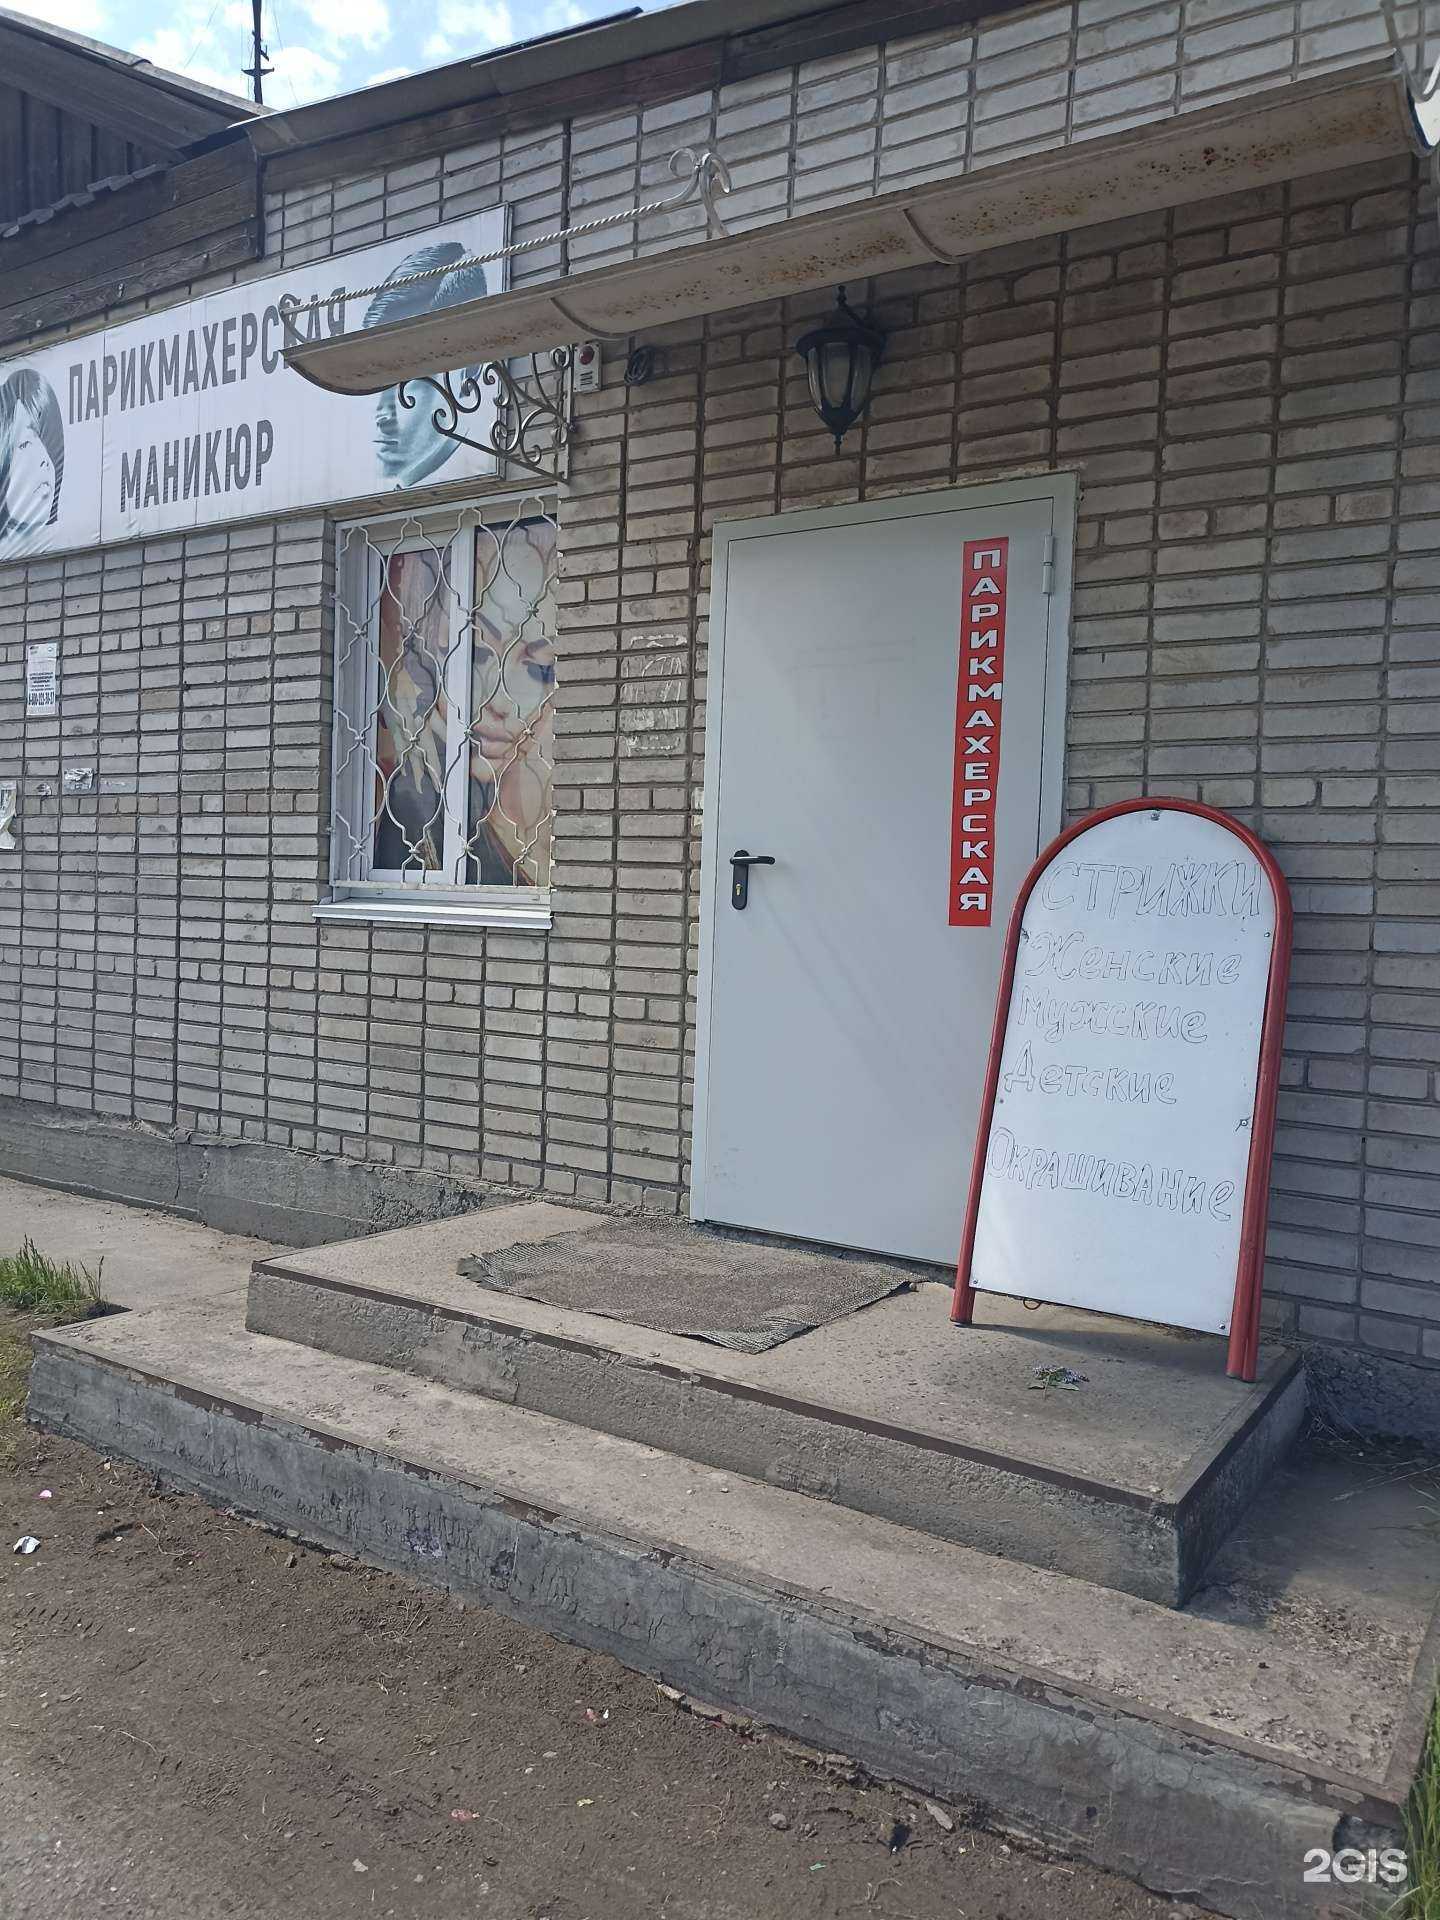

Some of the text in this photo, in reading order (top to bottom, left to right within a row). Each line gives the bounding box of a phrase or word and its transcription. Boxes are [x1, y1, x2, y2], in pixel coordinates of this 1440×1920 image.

[69, 286, 346, 425] ПАРИКМАХЕРСКАЯ
[120, 419, 274, 512] МАНИКЮР
[959, 549, 1003, 911] ПАРИКМАХЕРСКАЯ
[1041, 859, 1263, 920] СТРИЖКИ
[1024, 930, 1242, 986] Женские
[1017, 985, 1209, 1044] Мужские
[1003, 1039, 1177, 1105] Детские
